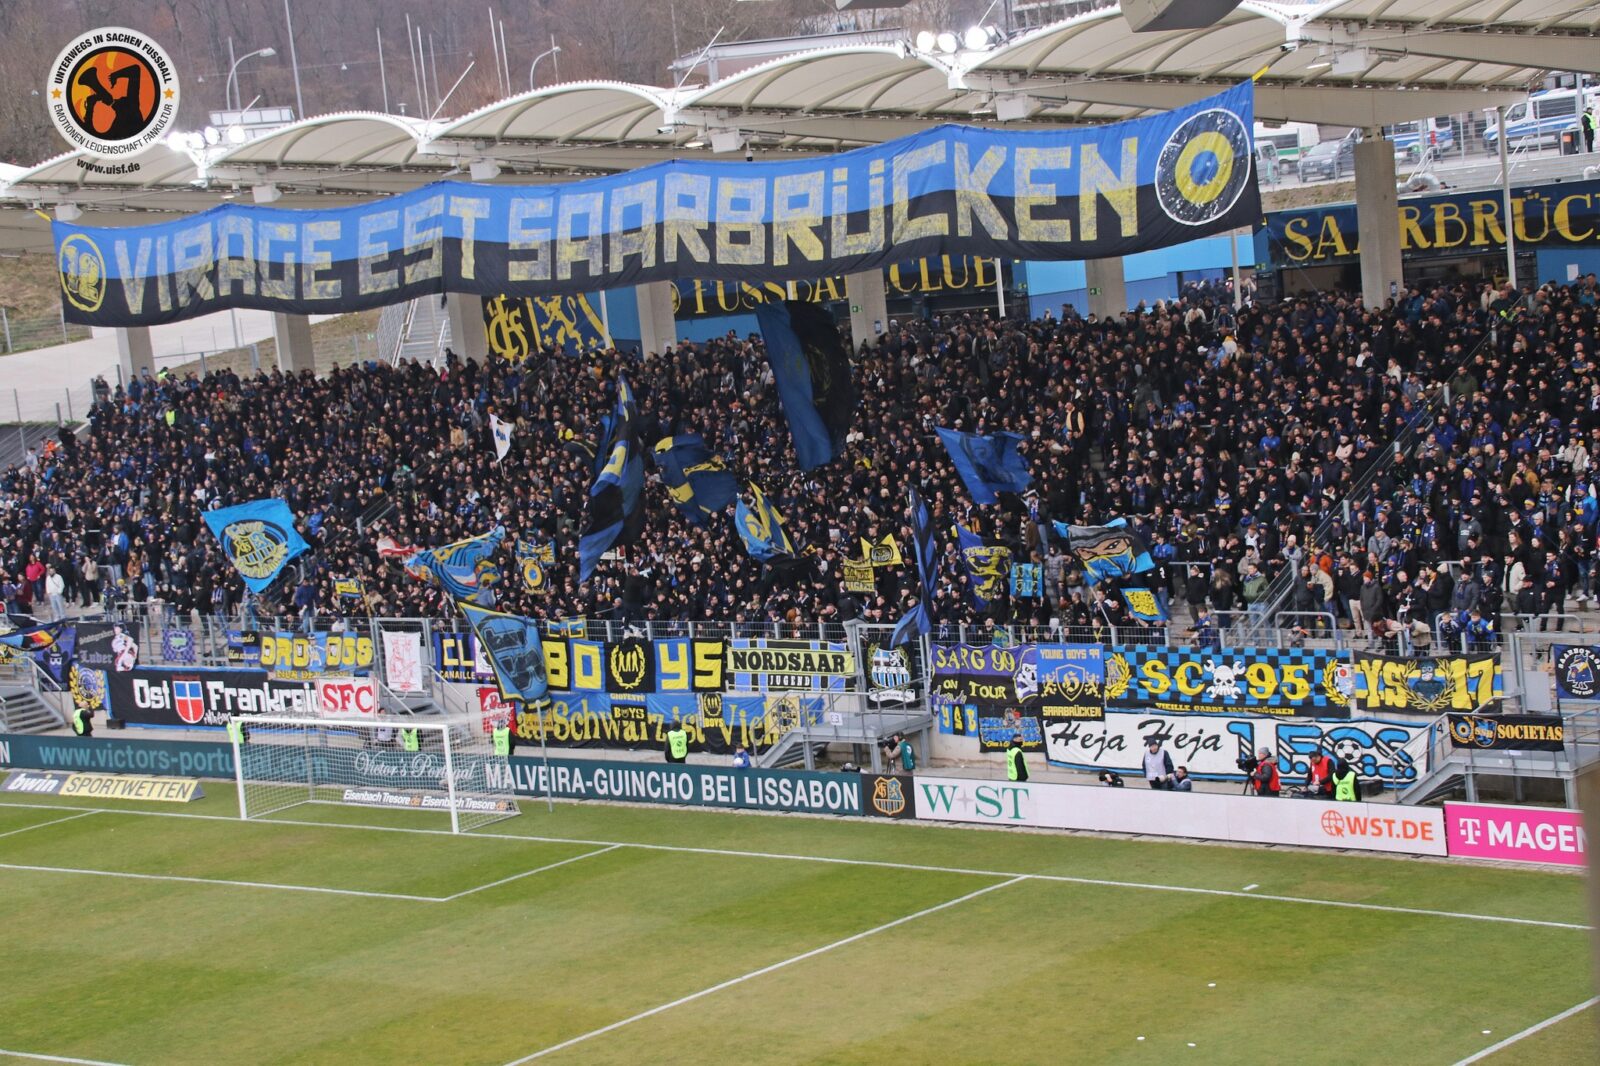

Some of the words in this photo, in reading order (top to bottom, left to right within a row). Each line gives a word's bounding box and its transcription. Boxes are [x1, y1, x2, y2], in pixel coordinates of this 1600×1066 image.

[114, 213, 342, 315] VIRAGE
[358, 194, 490, 296] EST
[508, 136, 1138, 282] SAARBRÜCKEN
[732, 650, 847, 673] NORDSAAR
[936, 649, 986, 670] SARG
[991, 650, 1016, 672] 99
[1040, 649, 1064, 660] YOUNG
[1066, 649, 1087, 660] BOYS
[769, 675, 811, 686] JUGEND
[943, 679, 958, 690] ON
[968, 680, 1008, 700] TOUR
[1139, 659, 1206, 696] SC
[1245, 662, 1311, 700] 95
[1361, 659, 1409, 708] YS
[1450, 658, 1494, 711] 17
[132, 678, 171, 710] Ost
[322, 683, 373, 714] SFC
[1042, 705, 1102, 718] SAARBRÜCKEN
[1045, 718, 1127, 762] Heja
[1137, 718, 1223, 763] Heja
[1497, 724, 1563, 741] SOCIETAS
[8, 773, 60, 792] bwin
[66, 776, 192, 799] SPORTWETTEN
[343, 789, 382, 803] Eisenbach
[486, 763, 694, 801] MALVEIRA-GUINCHO
[700, 774, 736, 803] BEI
[745, 777, 859, 811] LISSABON
[1346, 816, 1434, 841] WST.DE
